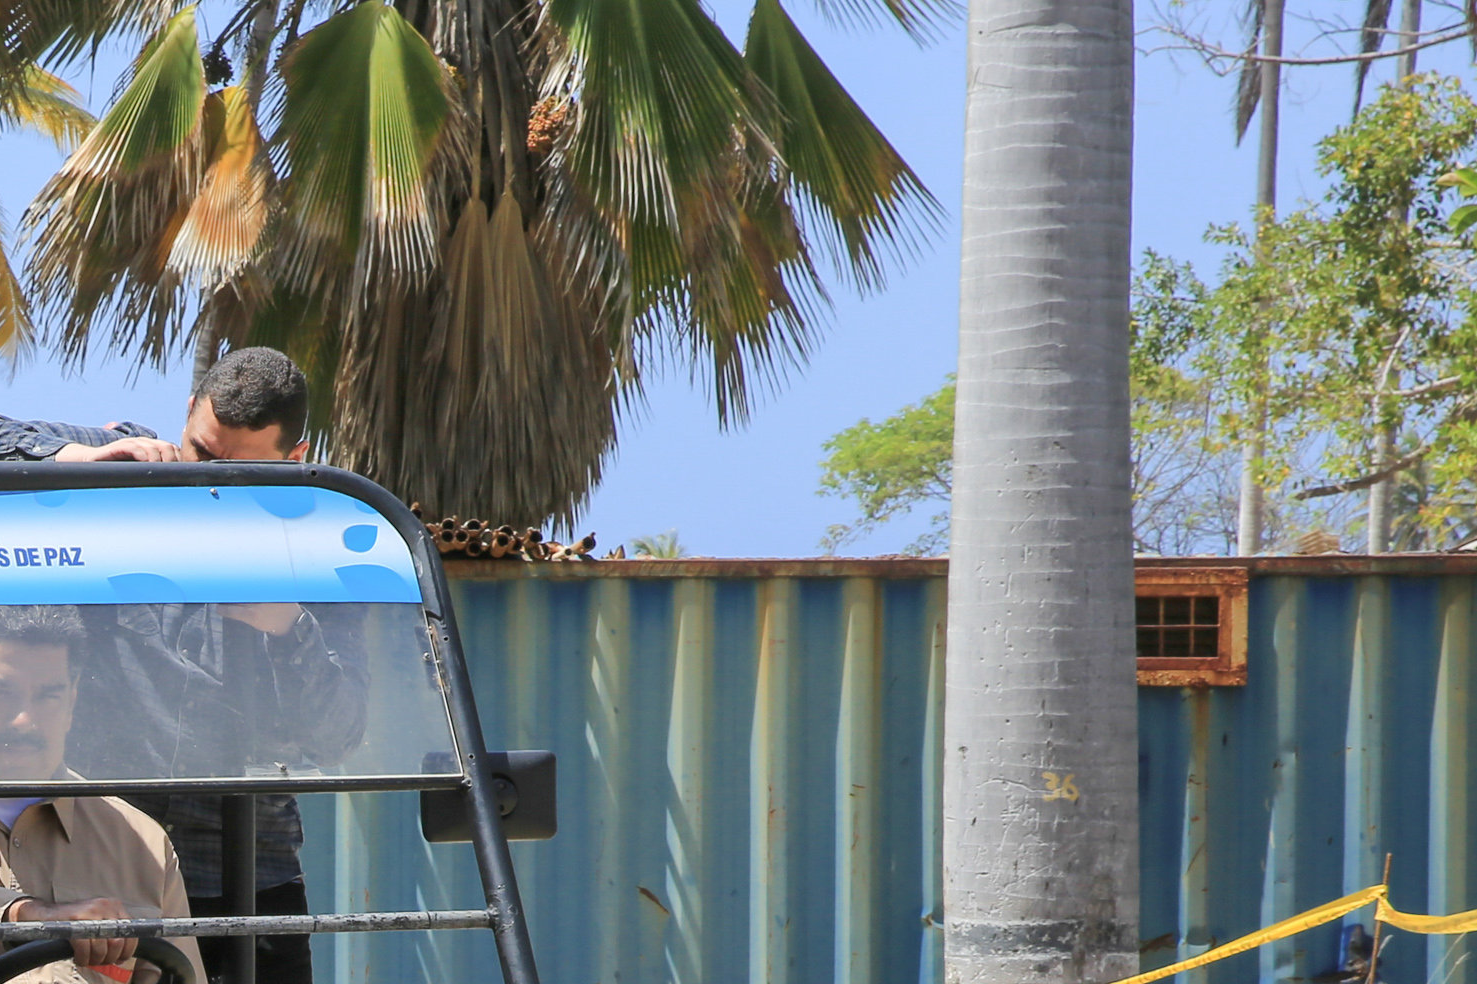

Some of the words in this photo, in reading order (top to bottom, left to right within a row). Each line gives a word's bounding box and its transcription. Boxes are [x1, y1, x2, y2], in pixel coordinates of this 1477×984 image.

[14, 547, 42, 568] DE
[43, 546, 85, 567] PAZ
[1041, 771, 1080, 802] 36
